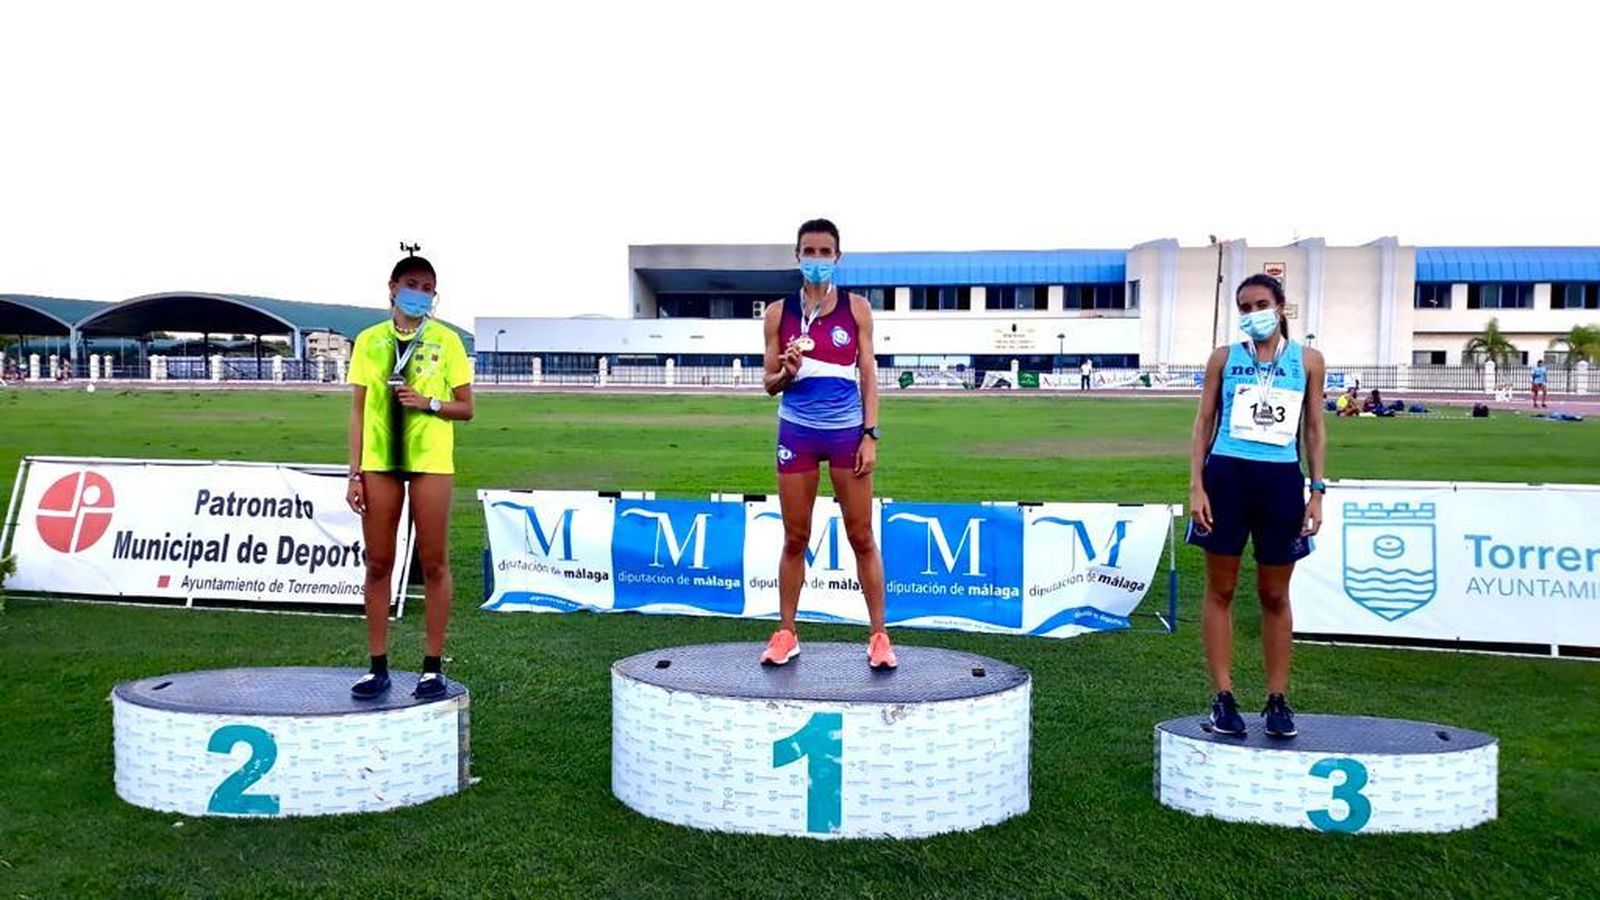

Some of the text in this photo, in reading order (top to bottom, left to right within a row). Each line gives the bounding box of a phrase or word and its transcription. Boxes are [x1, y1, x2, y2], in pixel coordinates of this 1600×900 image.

[1250, 403, 1286, 423] 13
[194, 489, 314, 520] Patronato
[112, 530, 231, 569] Municipal
[236, 534, 268, 564] de
[648, 511, 712, 570] M
[920, 516, 988, 577] M
[181, 575, 366, 596] Ayuntamiento de Torremolinos
[564, 568, 609, 583] málaga
[618, 571, 741, 590] diputación de málaga
[811, 577, 826, 590] de
[828, 578, 865, 594] mála
[1098, 573, 1146, 593] málaga
[886, 580, 1021, 600] diputación de málaga
[1465, 576, 1600, 600] AYUNTAMI
[206, 723, 281, 815] 2
[772, 711, 843, 834] 1
[1306, 757, 1373, 834] 3
